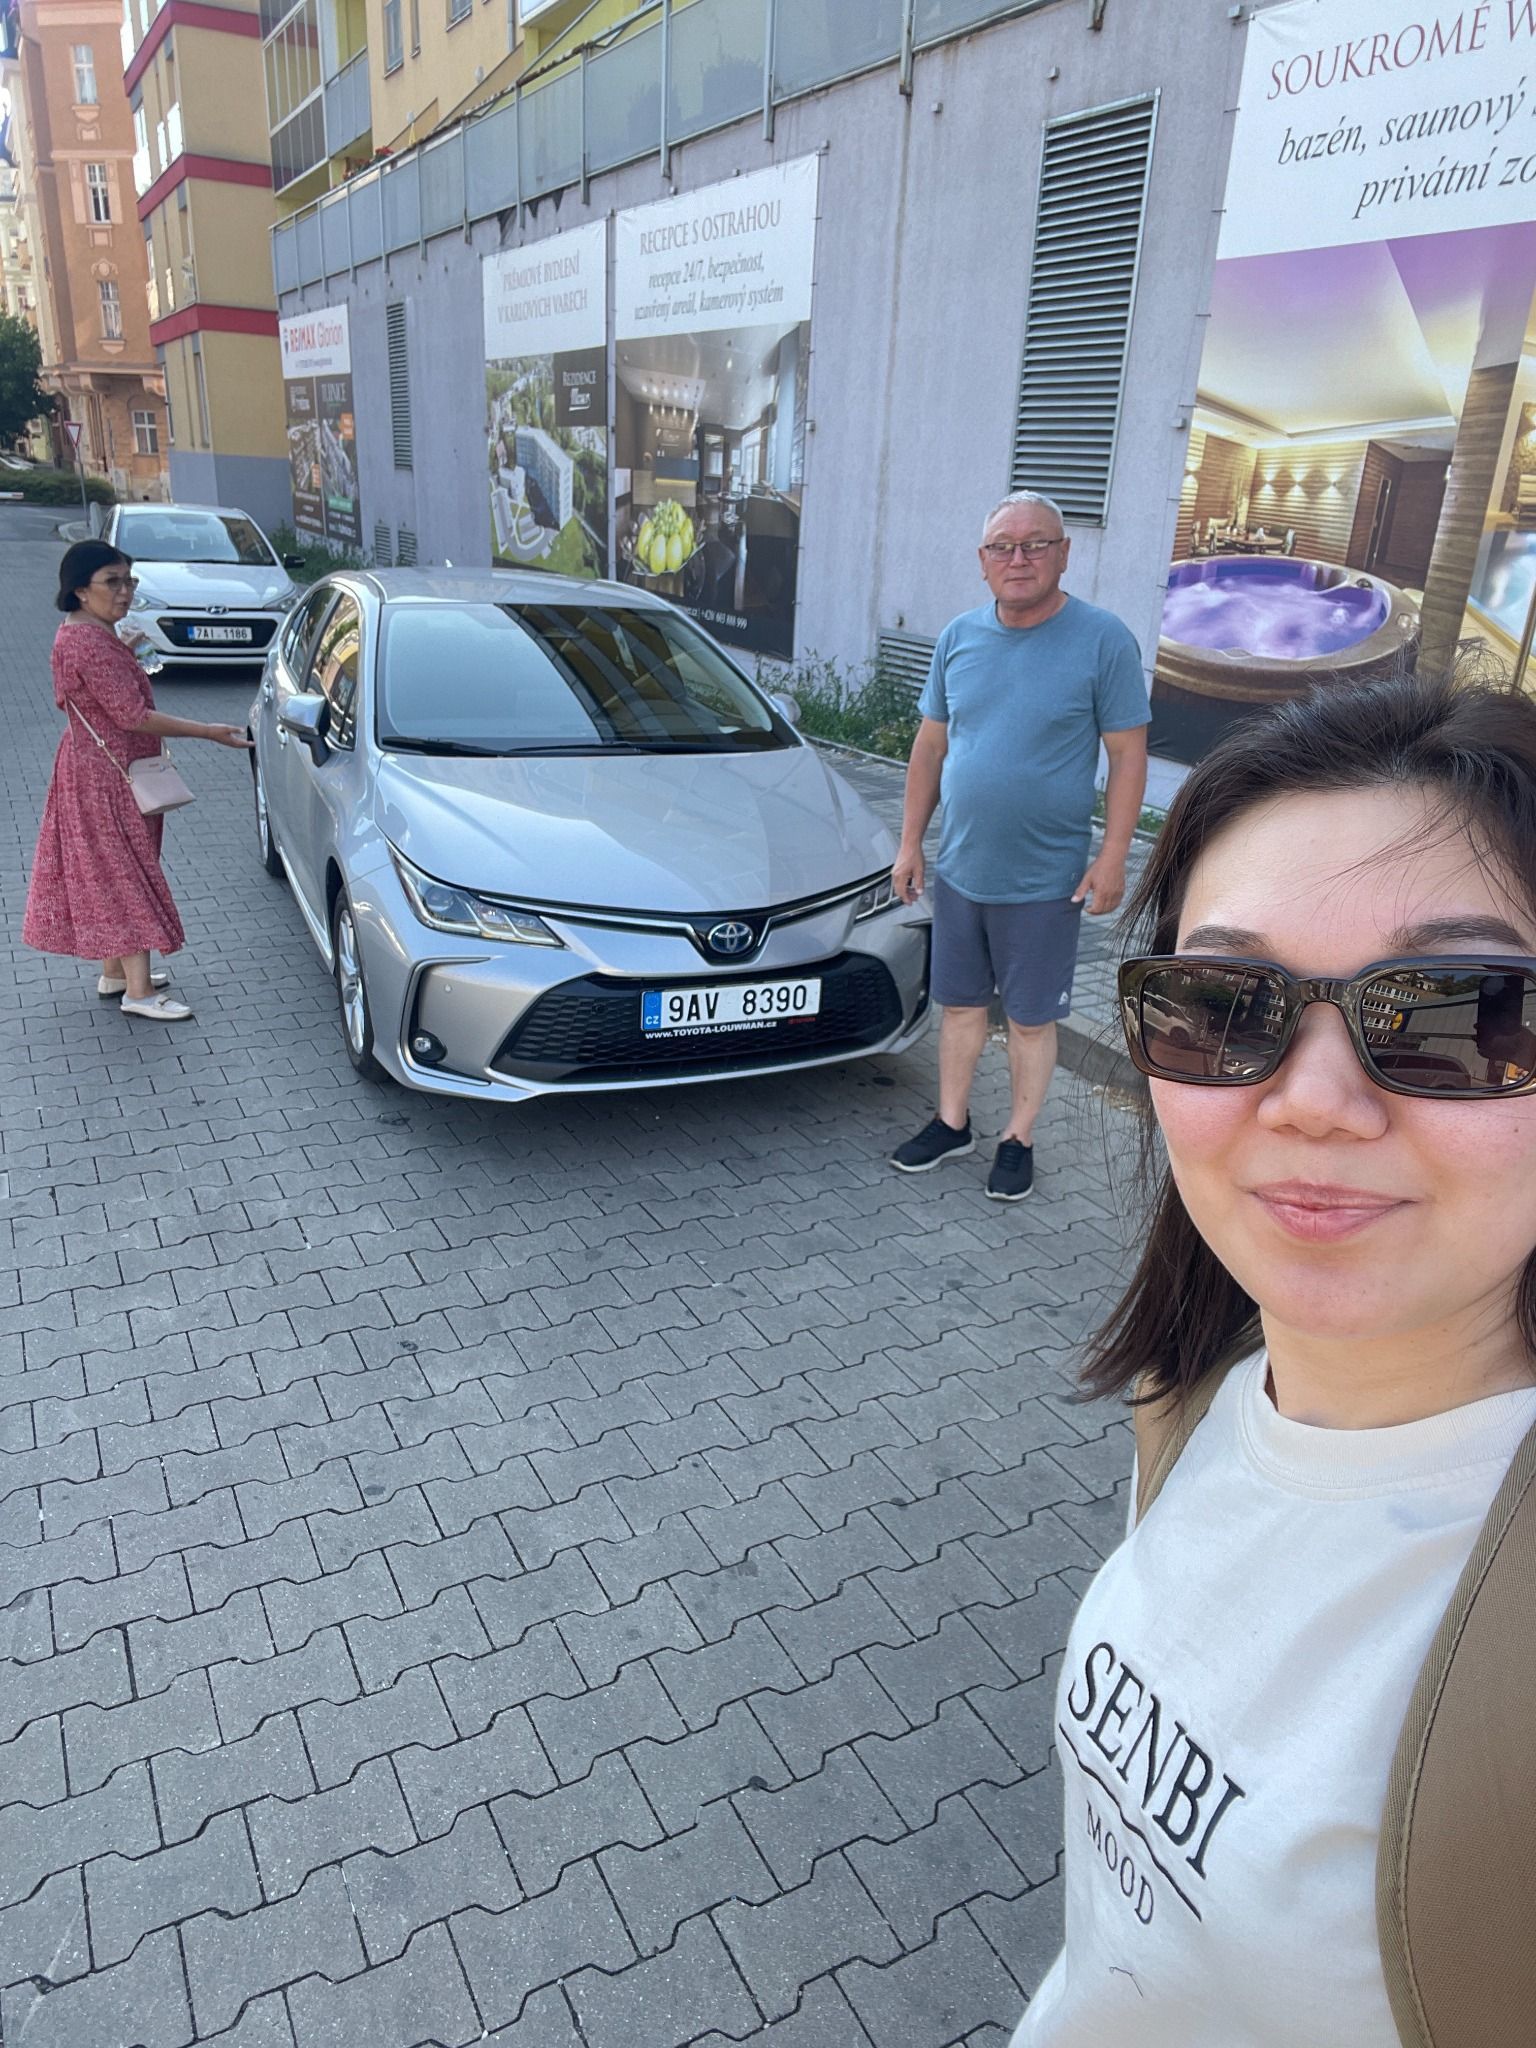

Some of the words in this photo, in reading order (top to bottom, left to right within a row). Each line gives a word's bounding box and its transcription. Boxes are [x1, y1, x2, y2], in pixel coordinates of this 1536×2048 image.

[1267, 0, 1491, 100] SOUKROMÉ
[1277, 115, 1367, 166] bazén,
[1379, 76, 1528, 146] saunový
[1351, 146, 1499, 220] privátní
[640, 222, 688, 255] RECEPCE
[692, 219, 699, 244] S
[702, 200, 781, 241] OSTRAHOU
[553, 288, 588, 314] VARECH
[649, 270, 682, 292] recepce
[700, 284, 747, 313] kamerový
[748, 279, 784, 311] systém
[645, 1016, 660, 1025] CZ
[669, 992, 720, 1022] 9AV
[742, 985, 807, 1015] 8390
[645, 1020, 777, 1040] www.TOYOTA-LOUWMAN.cz
[1068, 1641, 1246, 1880] SENBI
[1087, 1799, 1154, 1925] MOOD
